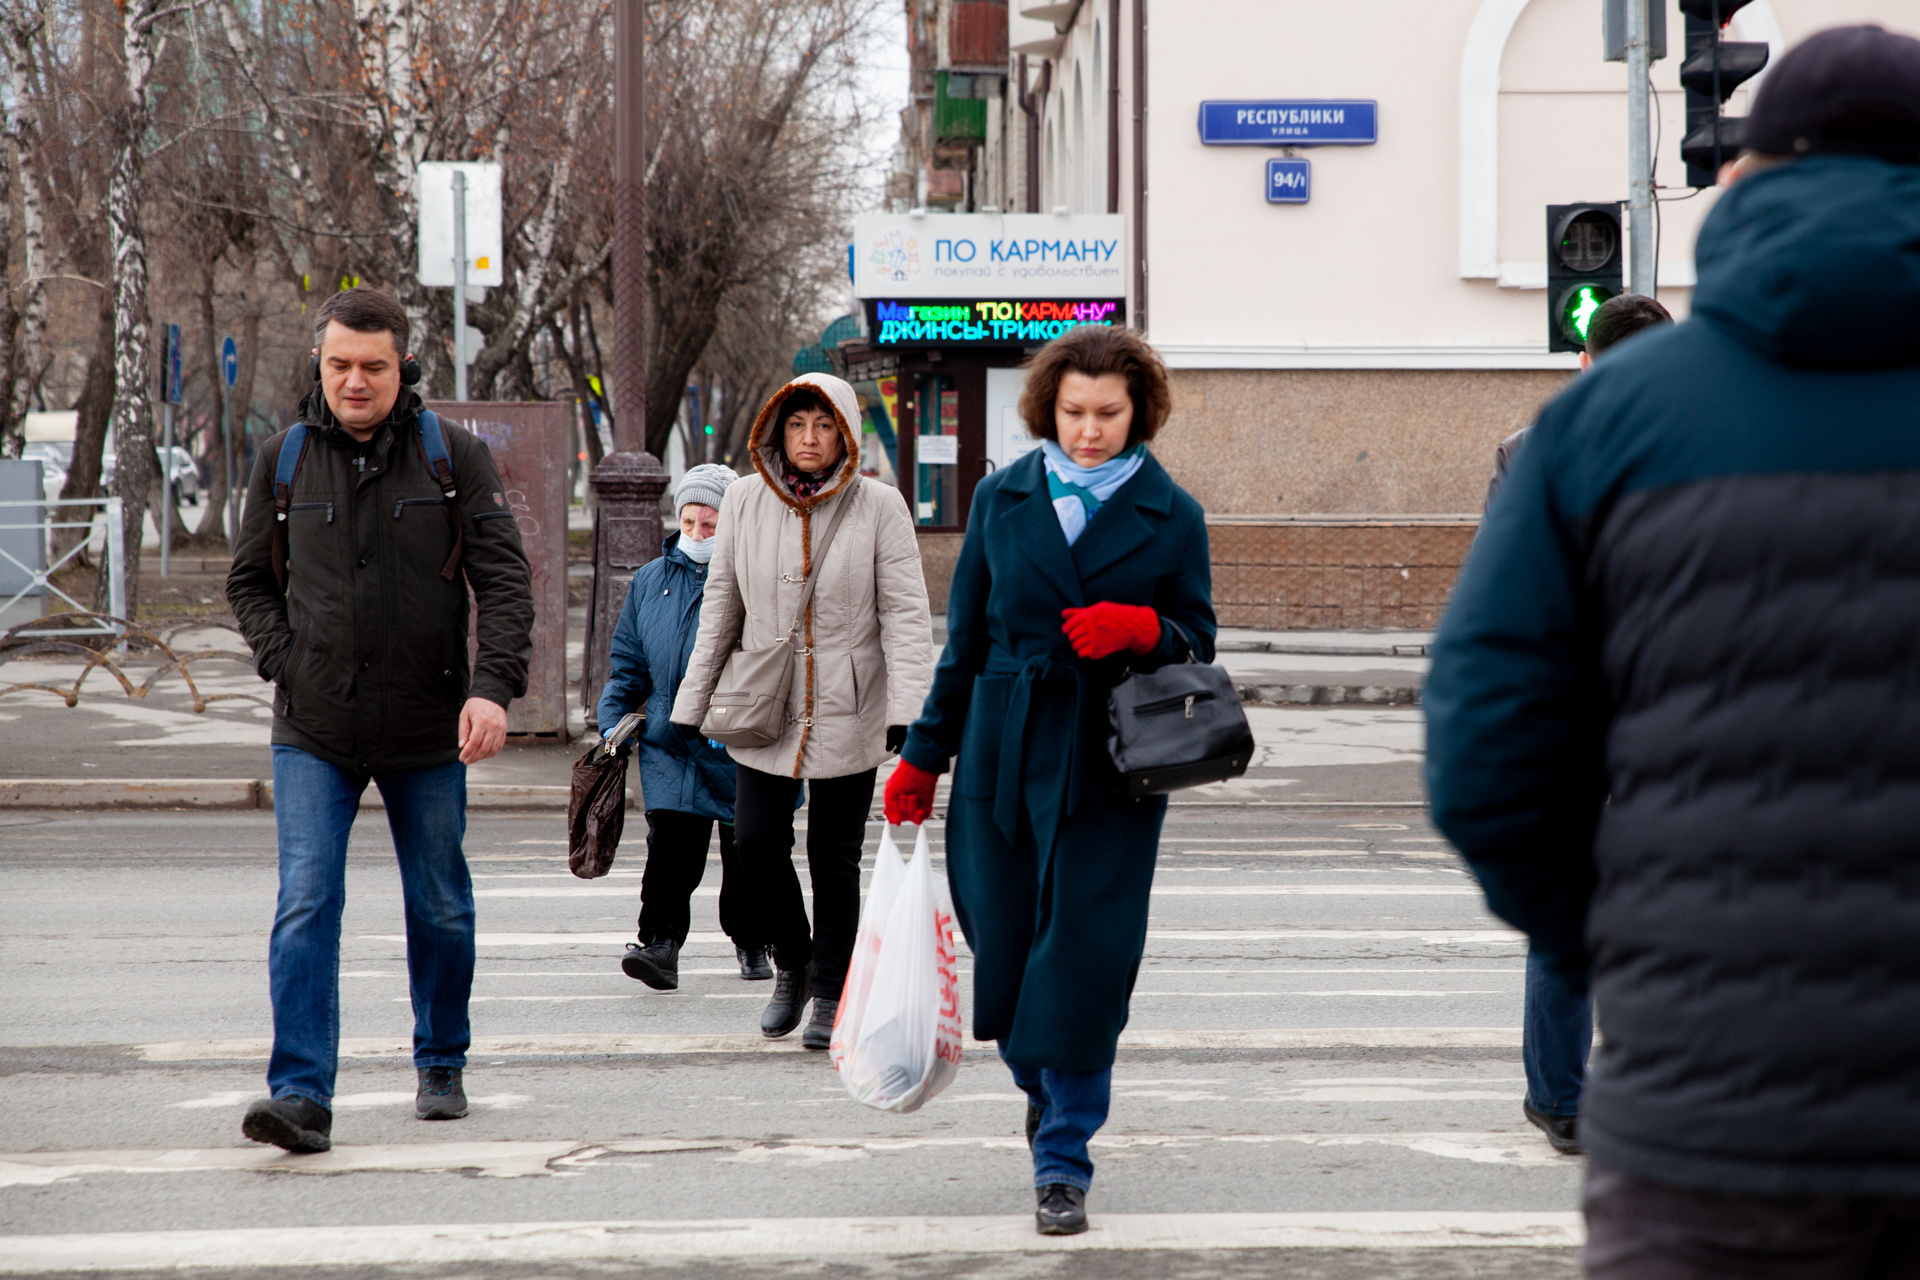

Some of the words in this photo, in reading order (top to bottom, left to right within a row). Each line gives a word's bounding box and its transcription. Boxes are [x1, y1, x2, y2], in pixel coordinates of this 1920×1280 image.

[1237, 110, 1344, 124] РЕСПУБЛИКИ
[1271, 128, 1309, 136] УЛИЦА
[1274, 172, 1305, 188] 94/1
[935, 240, 977, 262] ПО
[991, 240, 1118, 262] КАРМАНУ
[934, 265, 992, 279] покупай
[997, 268, 1005, 277] с
[1011, 265, 1119, 279] удовольствием
[878, 302, 970, 320] Магазин
